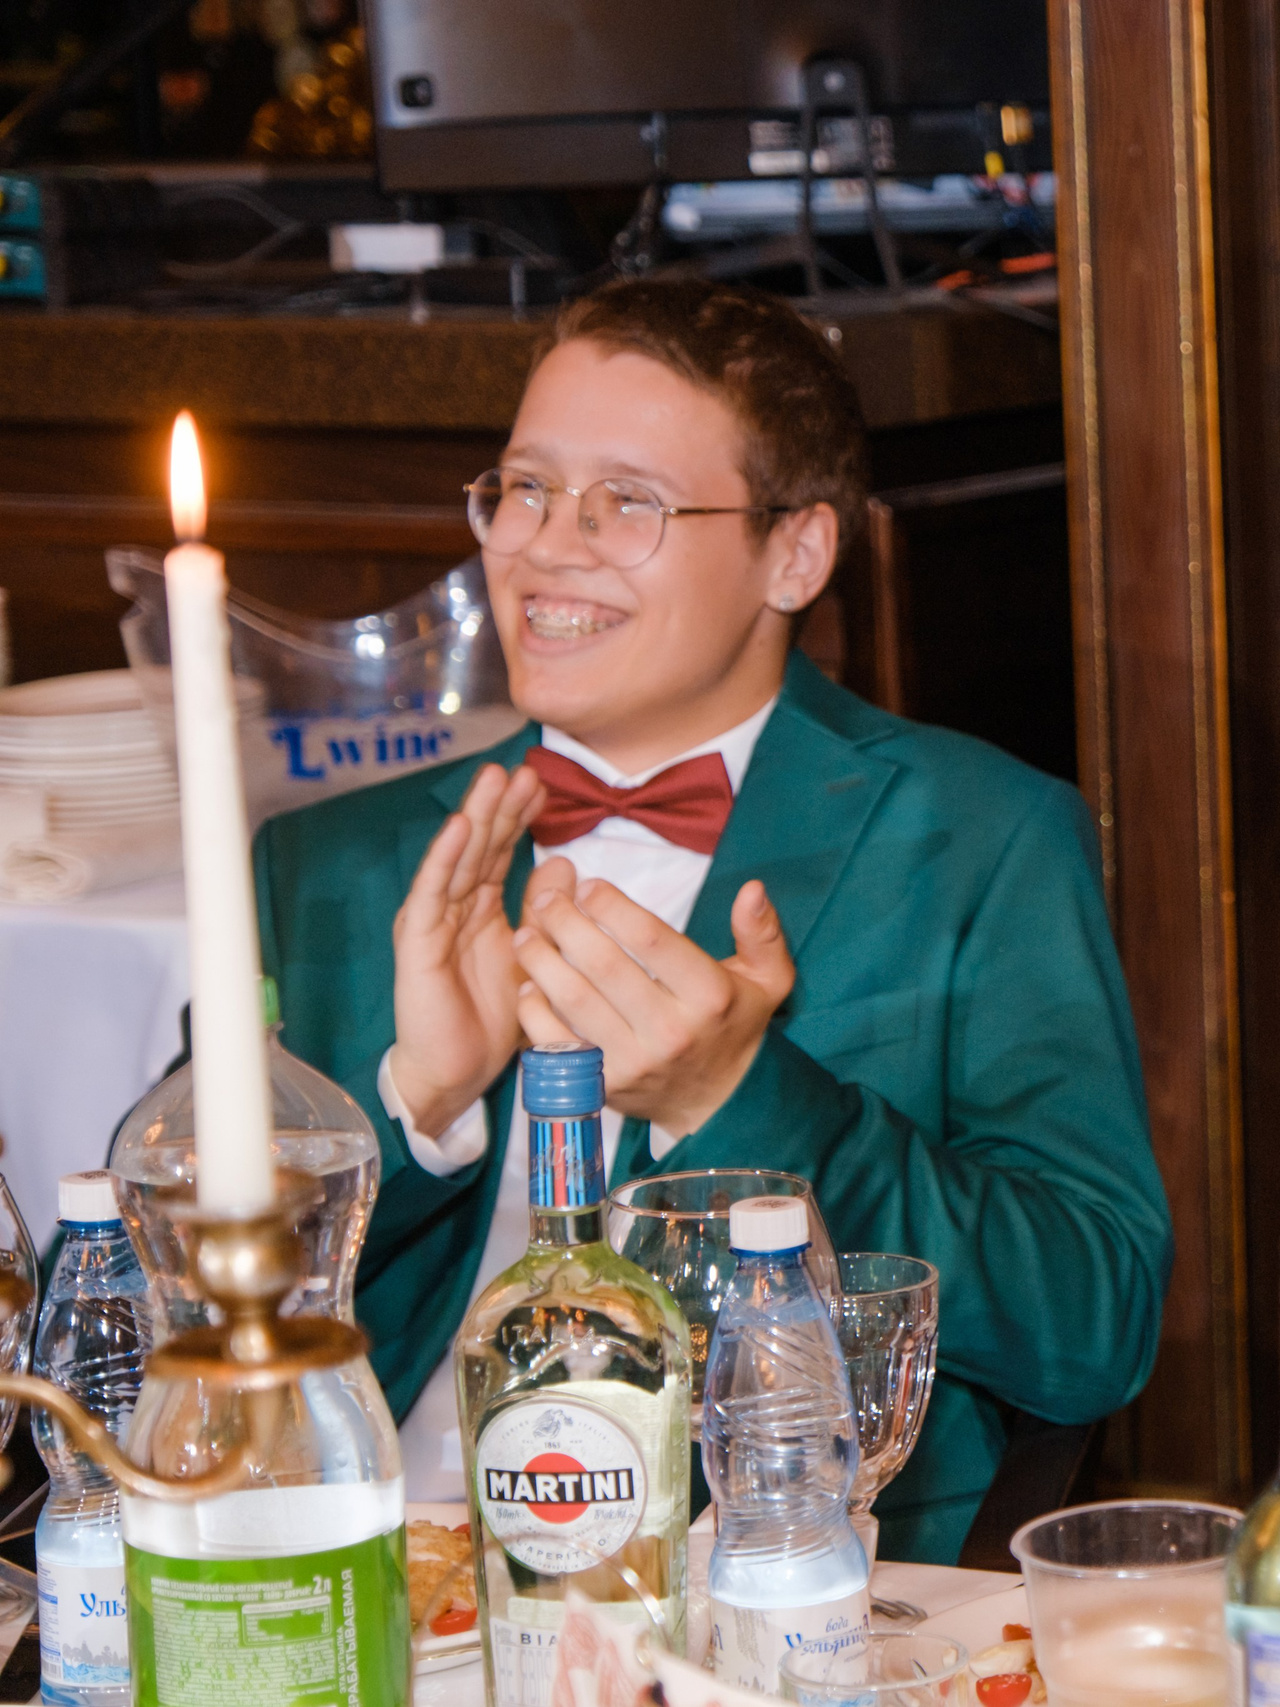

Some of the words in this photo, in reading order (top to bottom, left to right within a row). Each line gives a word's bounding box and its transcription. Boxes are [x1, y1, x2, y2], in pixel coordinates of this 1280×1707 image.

[488, 1469, 632, 1502] MARTINI
[80, 1592, 128, 1621] Уль
[336, 1626, 346, 1673] БУТЫЛКА
[339, 1673, 347, 1694] ЭТА
